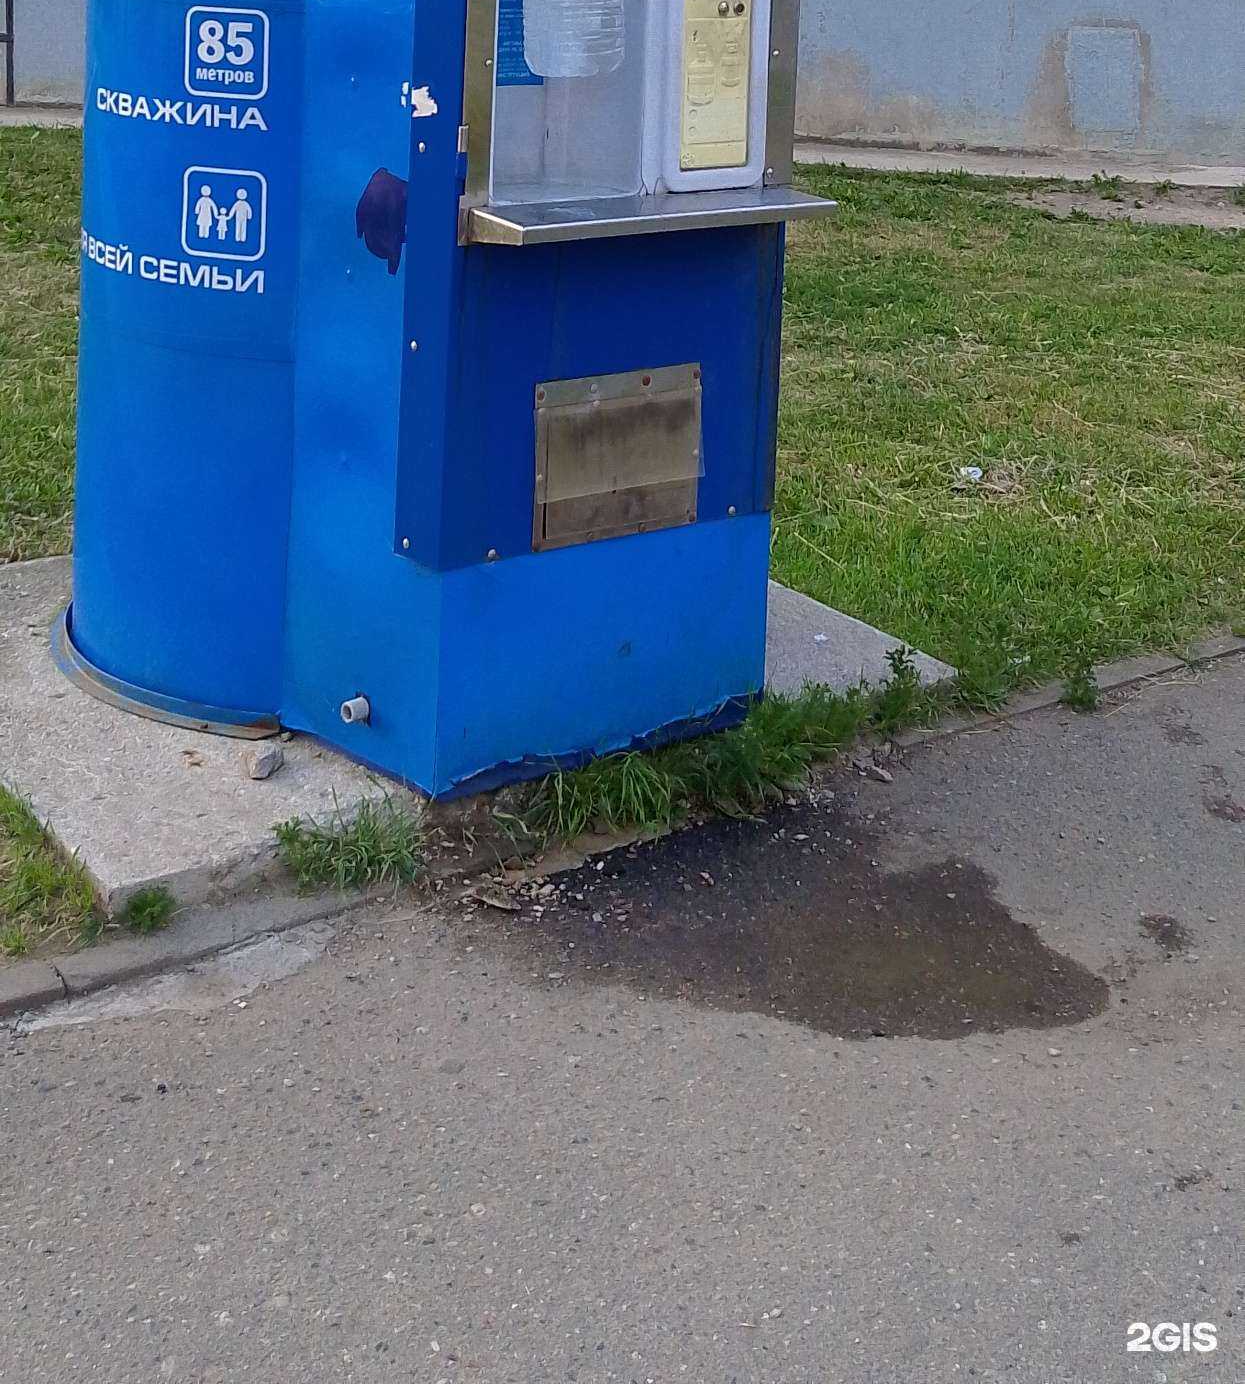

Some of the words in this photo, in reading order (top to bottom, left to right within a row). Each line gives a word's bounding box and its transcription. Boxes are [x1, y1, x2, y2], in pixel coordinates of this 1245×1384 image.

[197, 19, 254, 65] 85
[195, 67, 255, 85] метров
[96, 87, 269, 131] СКВАЖИНА
[88, 235, 133, 275] ВСЕЙ
[139, 255, 265, 294] СЕМЬИ
